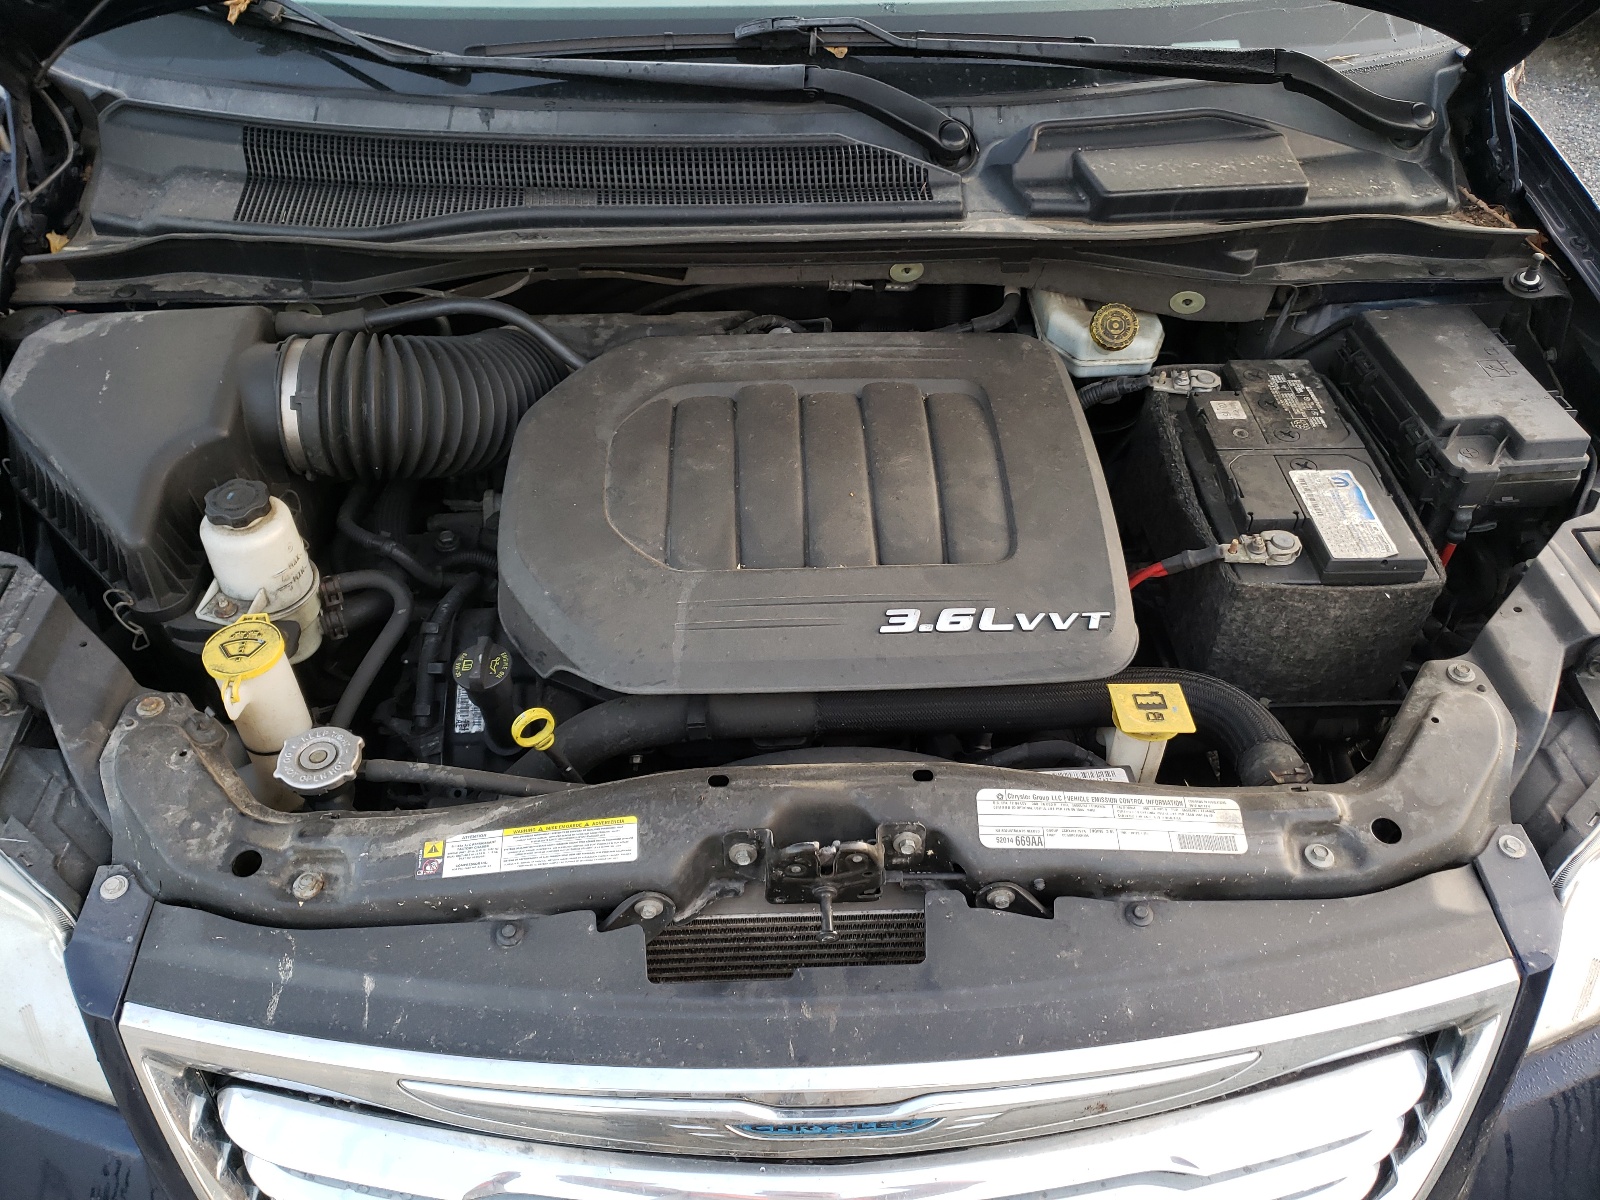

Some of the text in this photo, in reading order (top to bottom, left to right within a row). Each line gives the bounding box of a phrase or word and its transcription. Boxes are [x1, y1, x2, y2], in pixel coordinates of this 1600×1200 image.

[878, 607, 1015, 634] 3.6L
[301, 730, 329, 742] KEEP
[299, 772, 328, 782] OPEN
[1007, 793, 1062, 802] Chrysler Group LLC
[1066, 795, 1090, 803] VEHICLE
[1091, 796, 1118, 804] EMISSION
[1119, 797, 1144, 805] CONTROL
[1146, 798, 1184, 807] INFORMATION
[1015, 835, 1044, 847] 669AA
